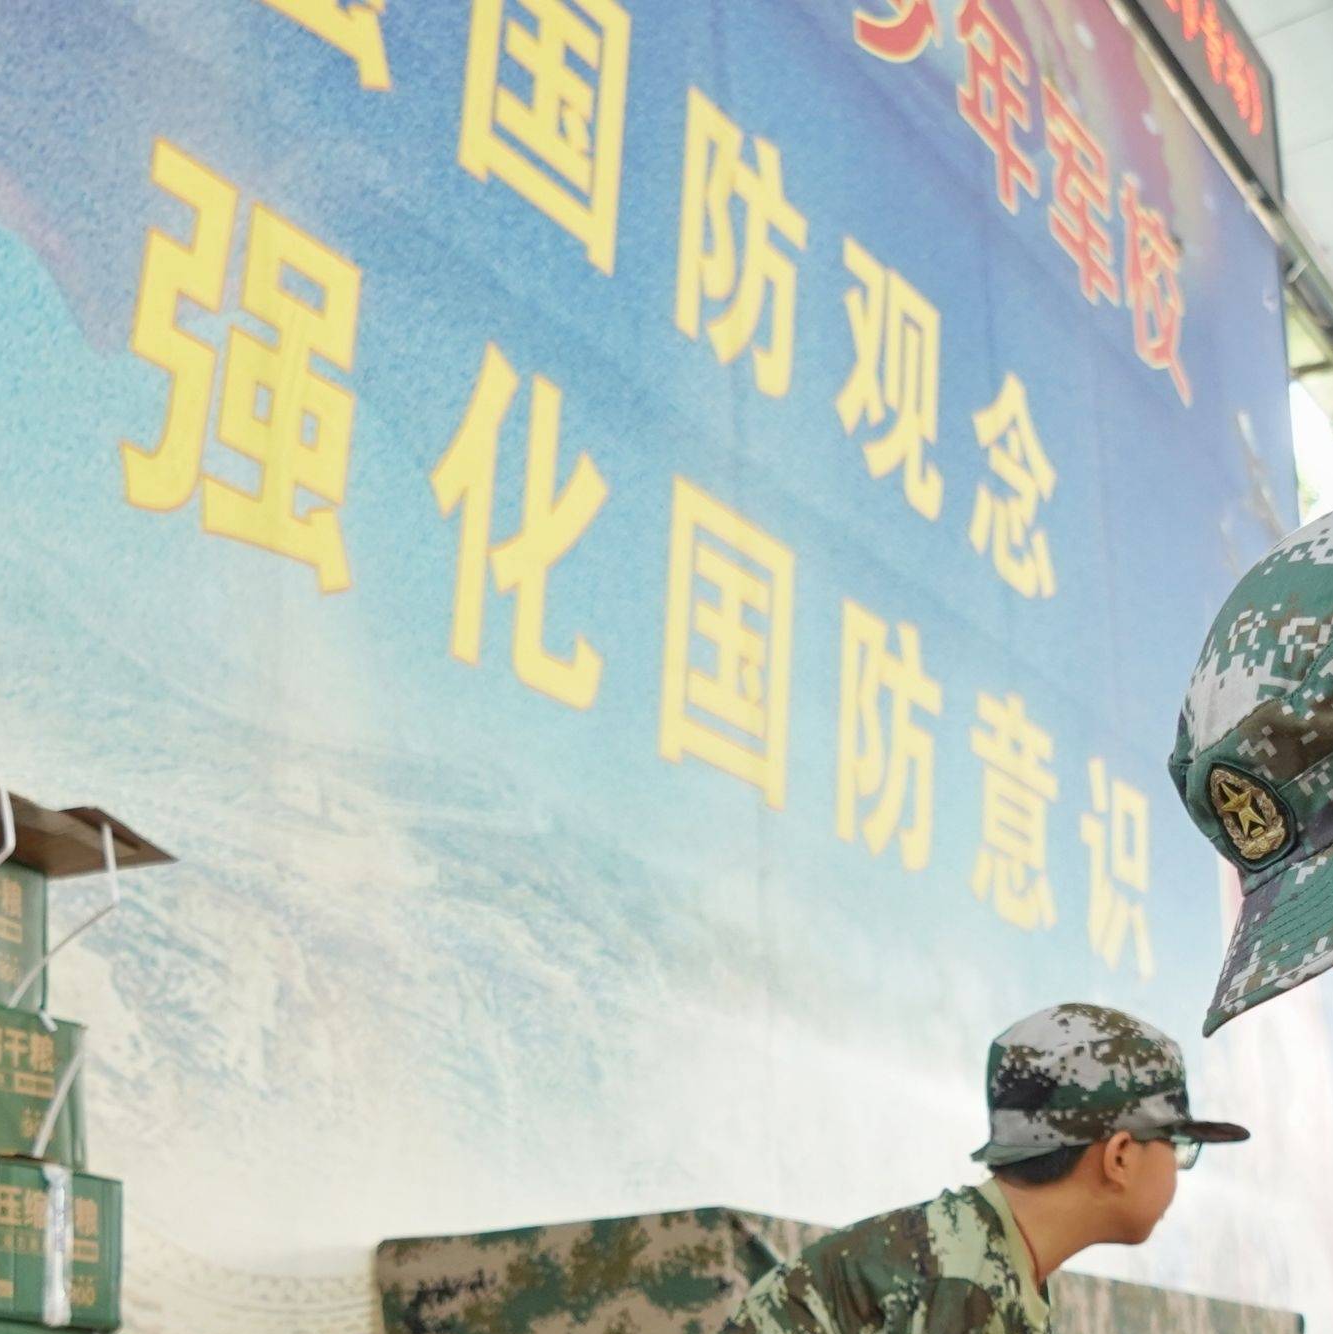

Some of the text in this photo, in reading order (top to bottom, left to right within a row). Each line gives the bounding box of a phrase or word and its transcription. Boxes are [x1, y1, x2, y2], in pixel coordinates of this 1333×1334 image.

[120, 137, 1154, 981] 强化国防意识
[259, 0, 1056, 597] 国防观念
